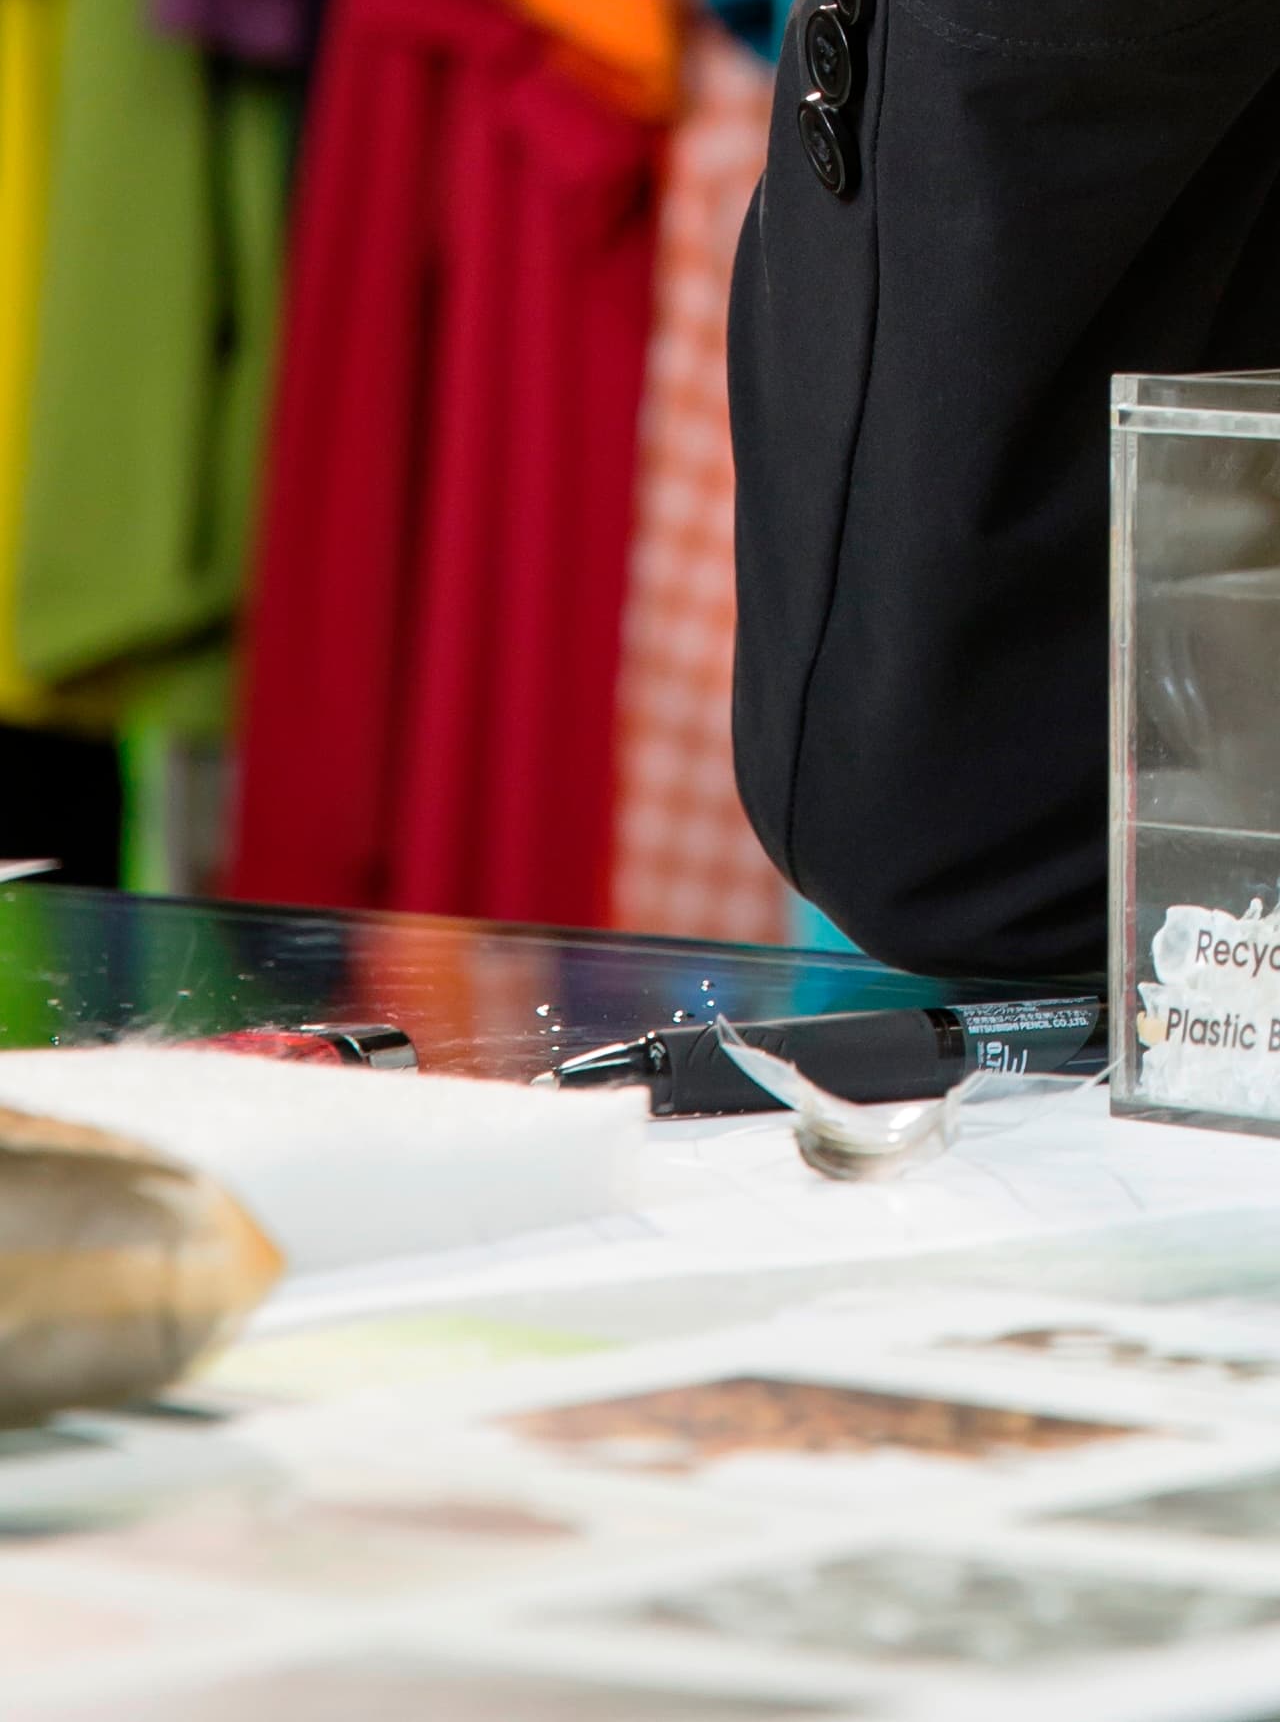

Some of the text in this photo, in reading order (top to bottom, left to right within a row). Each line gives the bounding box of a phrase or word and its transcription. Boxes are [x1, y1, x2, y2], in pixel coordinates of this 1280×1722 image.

[968, 1022, 1019, 1035] MITSUBISHI
[1020, 1020, 1052, 1032] PENCIL
[1164, 1007, 1257, 1050] Plastic
